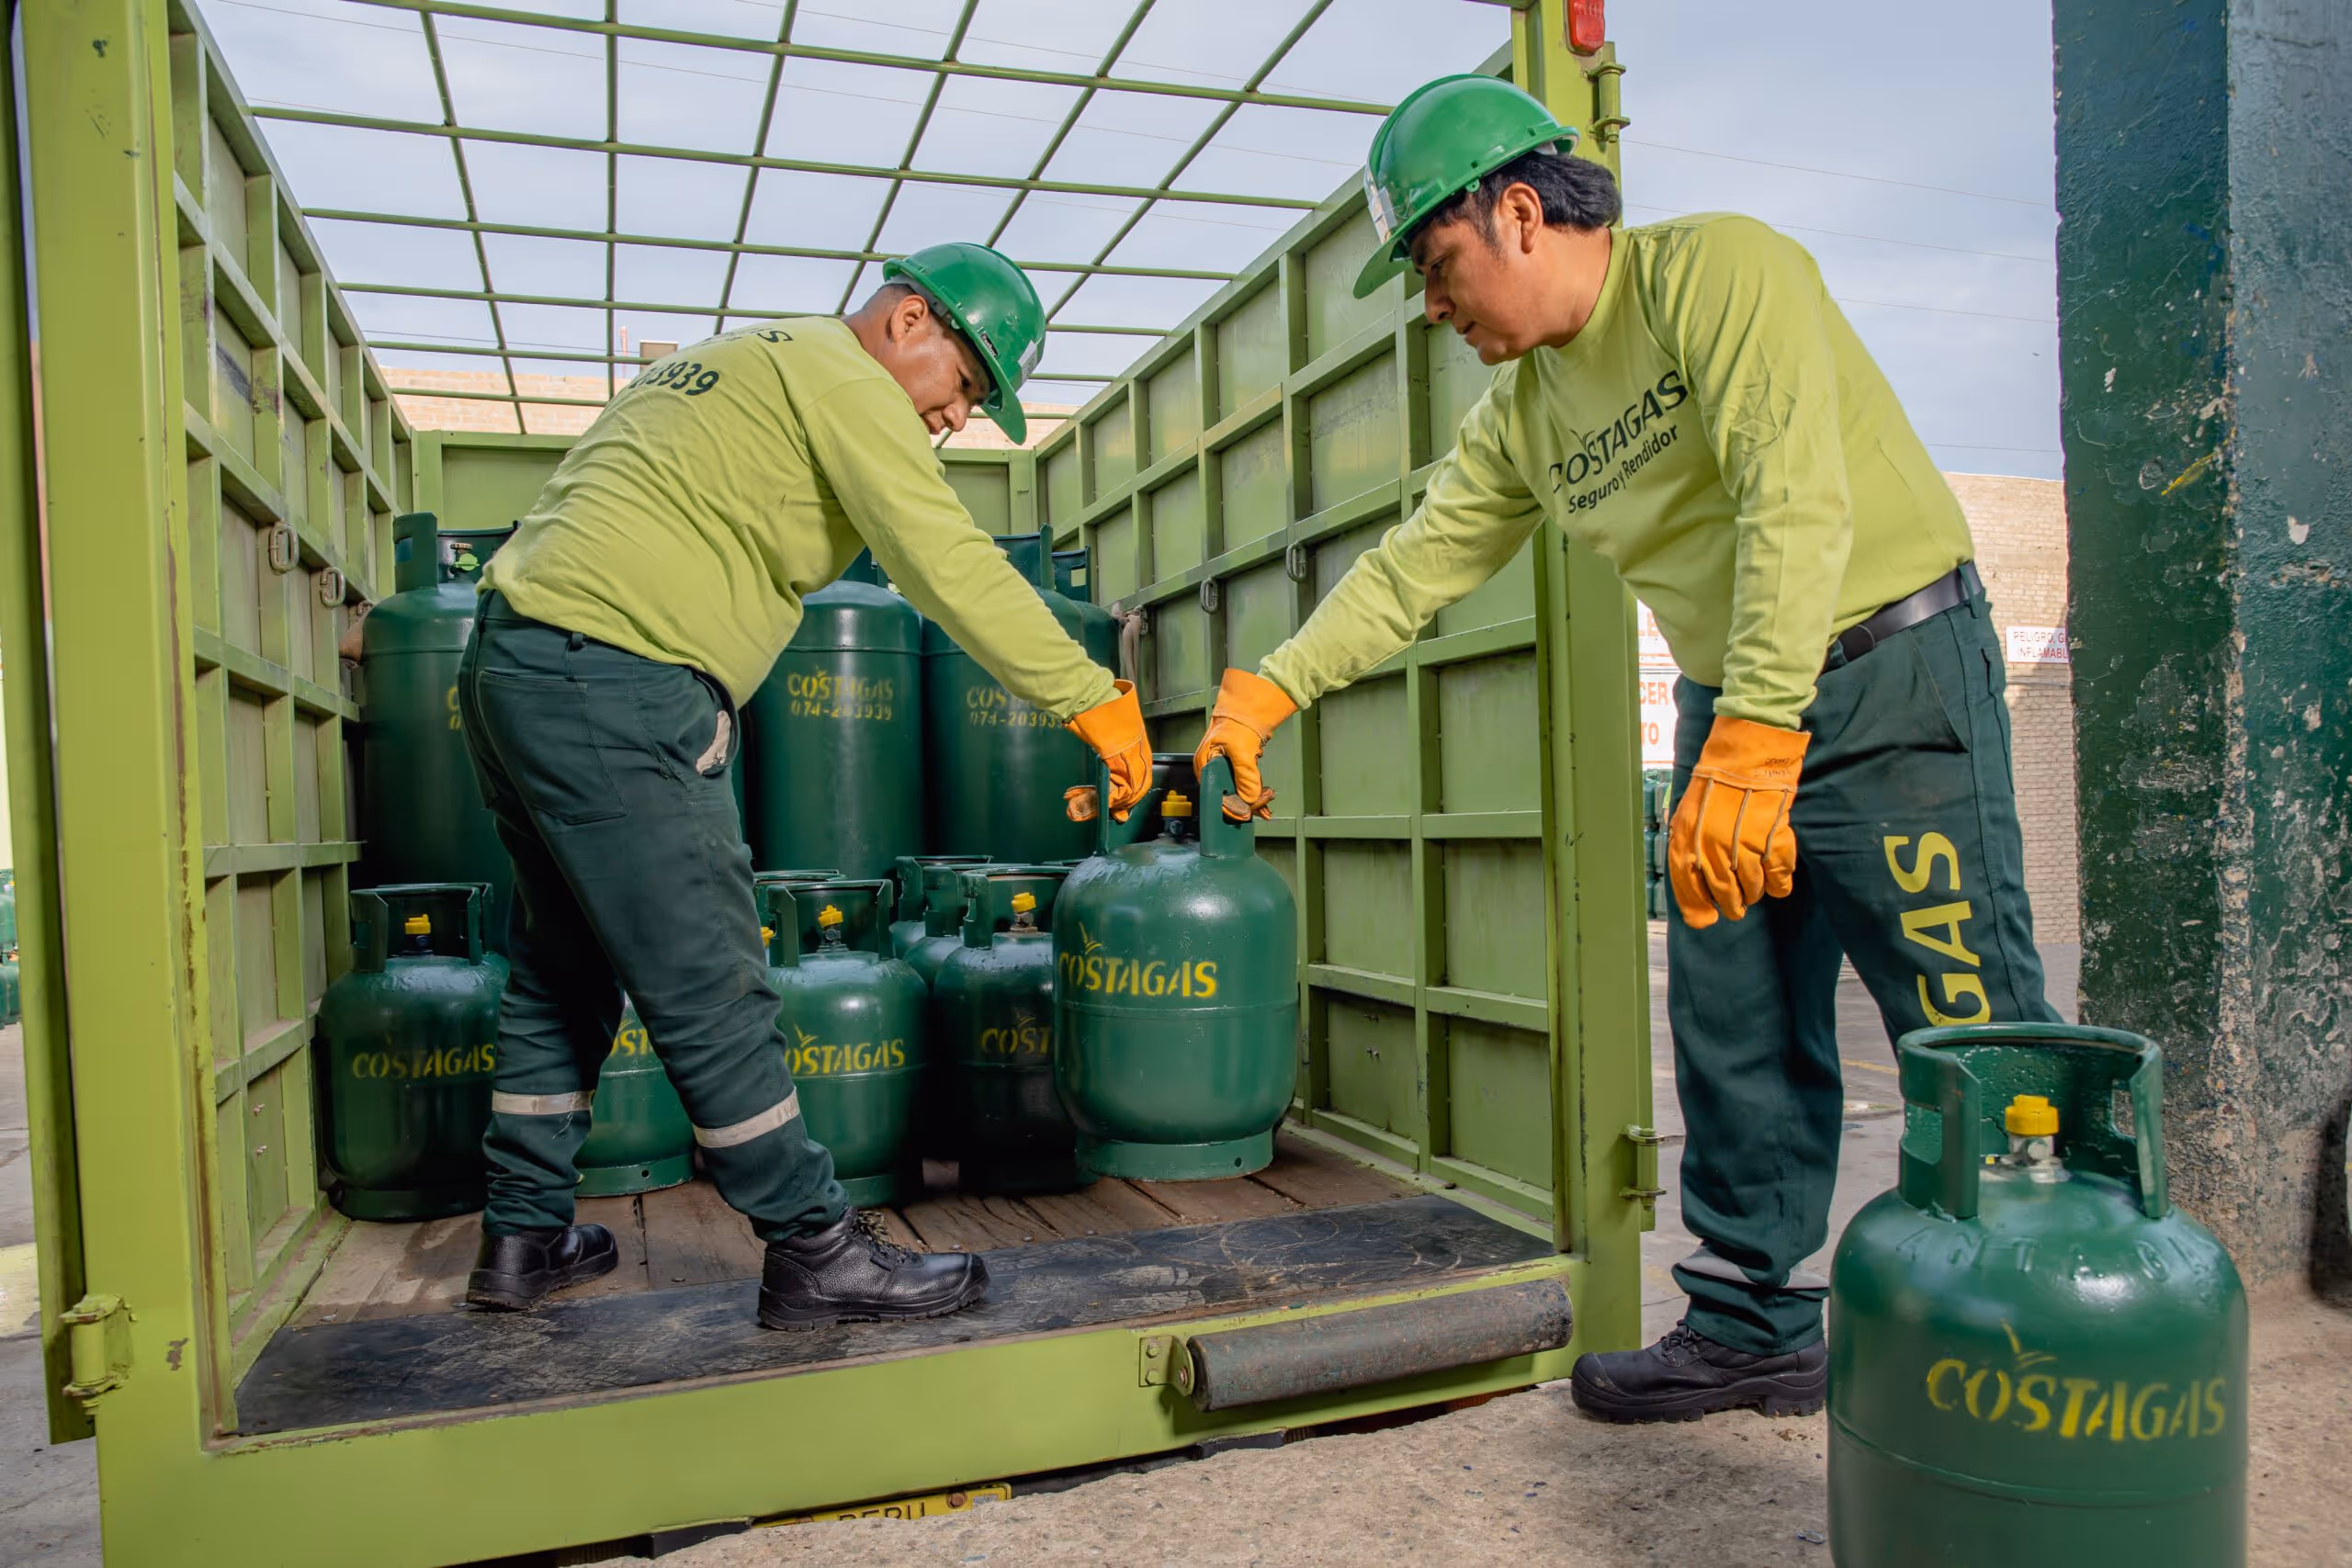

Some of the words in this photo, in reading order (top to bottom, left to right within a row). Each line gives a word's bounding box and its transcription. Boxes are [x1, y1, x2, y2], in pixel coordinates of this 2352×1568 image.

[1549, 369, 1688, 494] COSTAGAS
[1568, 476, 1620, 513] Seguro
[1617, 470, 1627, 490] y
[1622, 425, 1679, 480] Rendidor
[1883, 831, 1991, 1027] GAS
[1058, 952, 1217, 998] COSTAGAS
[352, 1043, 495, 1079] COSTAGAS
[1926, 1358, 2226, 1441] COSTAGAS
